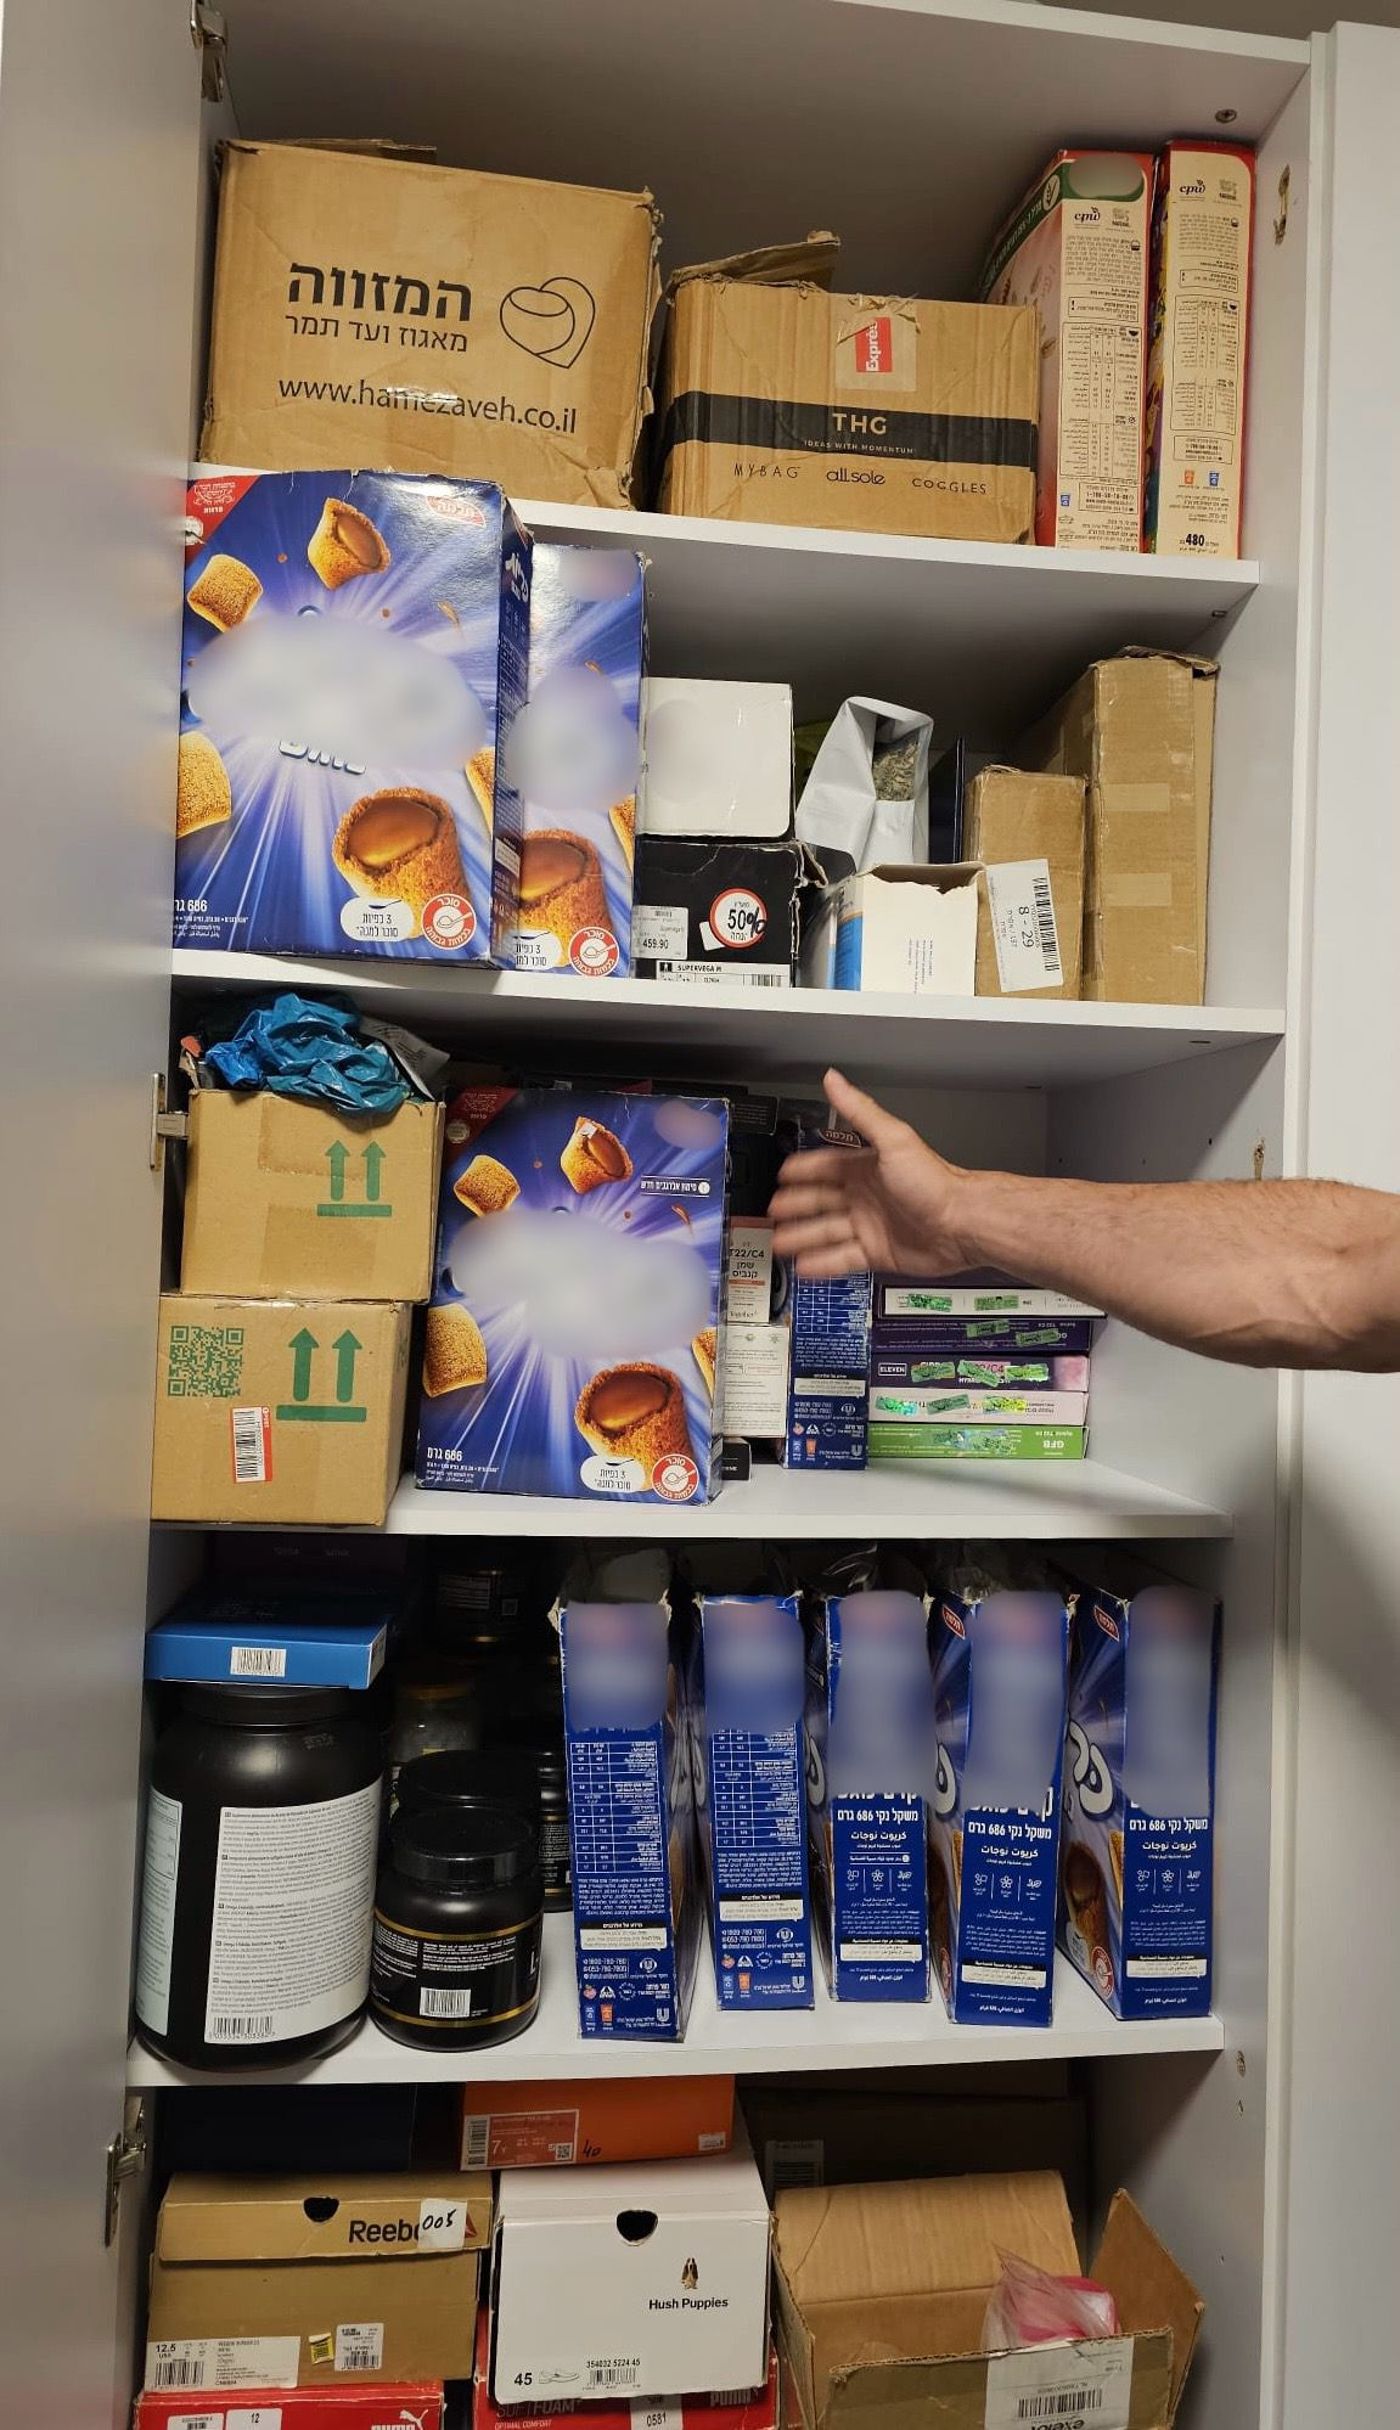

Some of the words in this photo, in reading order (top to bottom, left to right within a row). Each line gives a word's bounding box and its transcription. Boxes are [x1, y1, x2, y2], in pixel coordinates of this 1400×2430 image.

[288, 263, 472, 322] המזווה
[285, 315, 339, 338] תמר
[349, 321, 390, 344] ועד
[399, 326, 468, 352] מאגוז
[832, 413, 888, 436] THG
[804, 440, 831, 449] IDEAS
[836, 442, 859, 451] WITH
[861, 444, 914, 454] MOMENTUM
[826, 468, 886, 485] allsole
[912, 478, 987, 494] COGGLES
[1185, 533, 1205, 547] 480
[175, 899, 186, 912] גר
[188, 899, 208, 912] 686
[437, 897, 460, 908] סוכר
[1018, 906, 1030, 916] 8
[362, 913, 384, 925] כפיות
[386, 914, 392, 925] 3
[382, 928, 399, 938] סוכר
[585, 929, 605, 940] סוכר
[1021, 930, 1035, 948] 29
[736, 1261, 755, 1270] שמן
[732, 1270, 759, 1279] קנביס
[880, 1365, 906, 1373] ELEVEN
[427, 1447, 443, 1460] גרם
[444, 1449, 463, 1462] 686
[665, 1457, 686, 1467] סוכר
[837, 1810, 854, 1821] גרם
[857, 1810, 874, 1822] 686
[875, 1811, 890, 1825] נקי
[892, 1808, 918, 1825] משקל
[968, 1821, 986, 1834] גרם
[988, 1823, 1005, 1836] 686
[1129, 1819, 1147, 1831] גרם
[1149, 1819, 1166, 1831] 686
[1168, 1819, 1181, 1835] נקי
[1183, 1817, 1208, 1834] משקל
[1008, 1825, 1022, 1840] נקי
[1025, 1823, 1052, 1842] משקל
[422, 2209, 457, 2231] 005
[349, 2219, 420, 2243] Reeb
[648, 2298, 679, 2310] Hush
[682, 2296, 729, 2311] Puppies
[156, 2343, 176, 2353] 12.5
[631, 2358, 641, 2366] 45
[513, 2372, 533, 2386] 45
[250, 2412, 260, 2424] 12
